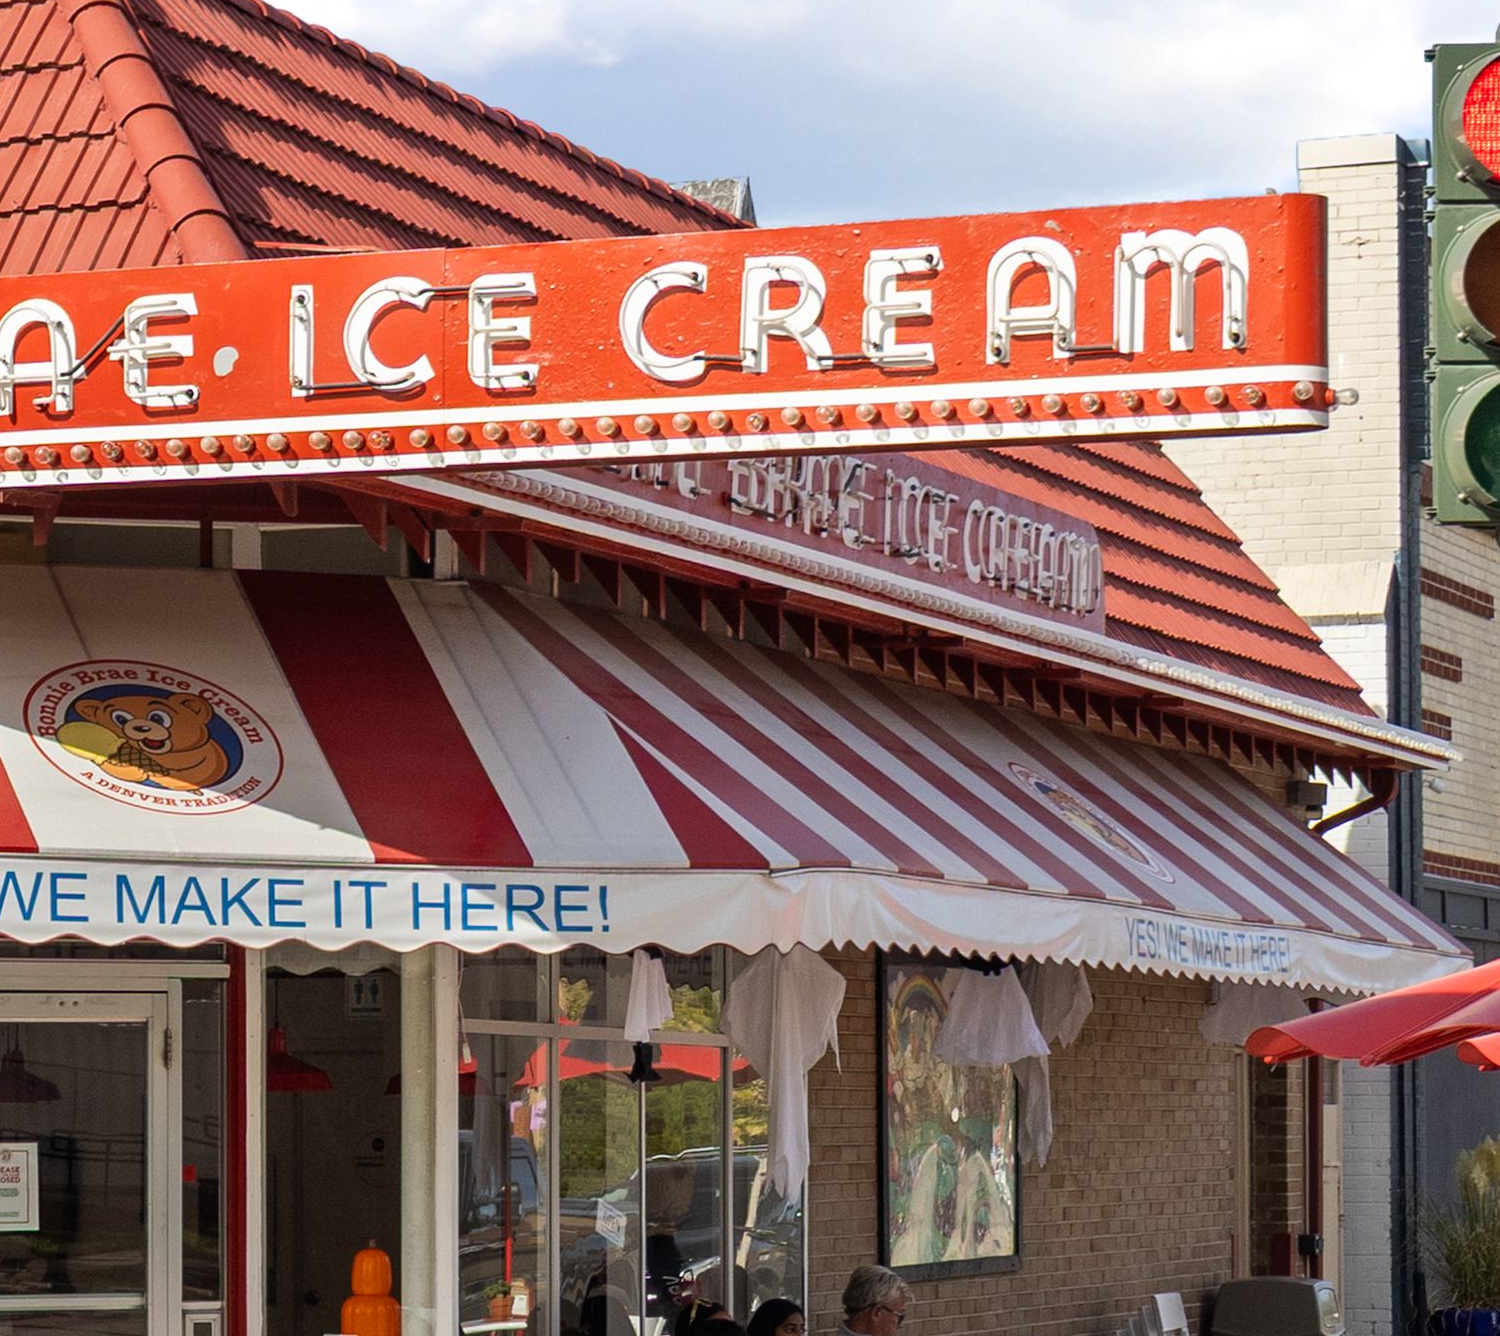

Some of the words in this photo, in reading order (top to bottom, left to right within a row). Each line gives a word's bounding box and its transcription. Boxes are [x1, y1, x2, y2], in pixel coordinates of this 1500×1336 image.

[288, 271, 537, 398] ICE
[617, 224, 1249, 383] CREAM
[36, 680, 76, 738] Bonnie
[70, 668, 140, 687] Brae
[145, 669, 192, 692] Ice
[197, 686, 265, 746] Cream
[97, 776, 178, 808] DENVER
[180, 776, 263, 809] TRADITION
[114, 873, 308, 929] MAKE
[333, 878, 389, 932] IT
[410, 882, 612, 935] HERE!
[1124, 916, 1161, 960] YES!
[1163, 921, 1189, 964] WE
[1191, 927, 1232, 969] MAKE
[1233, 932, 1247, 970] IT
[1248, 934, 1293, 973] HERE!
